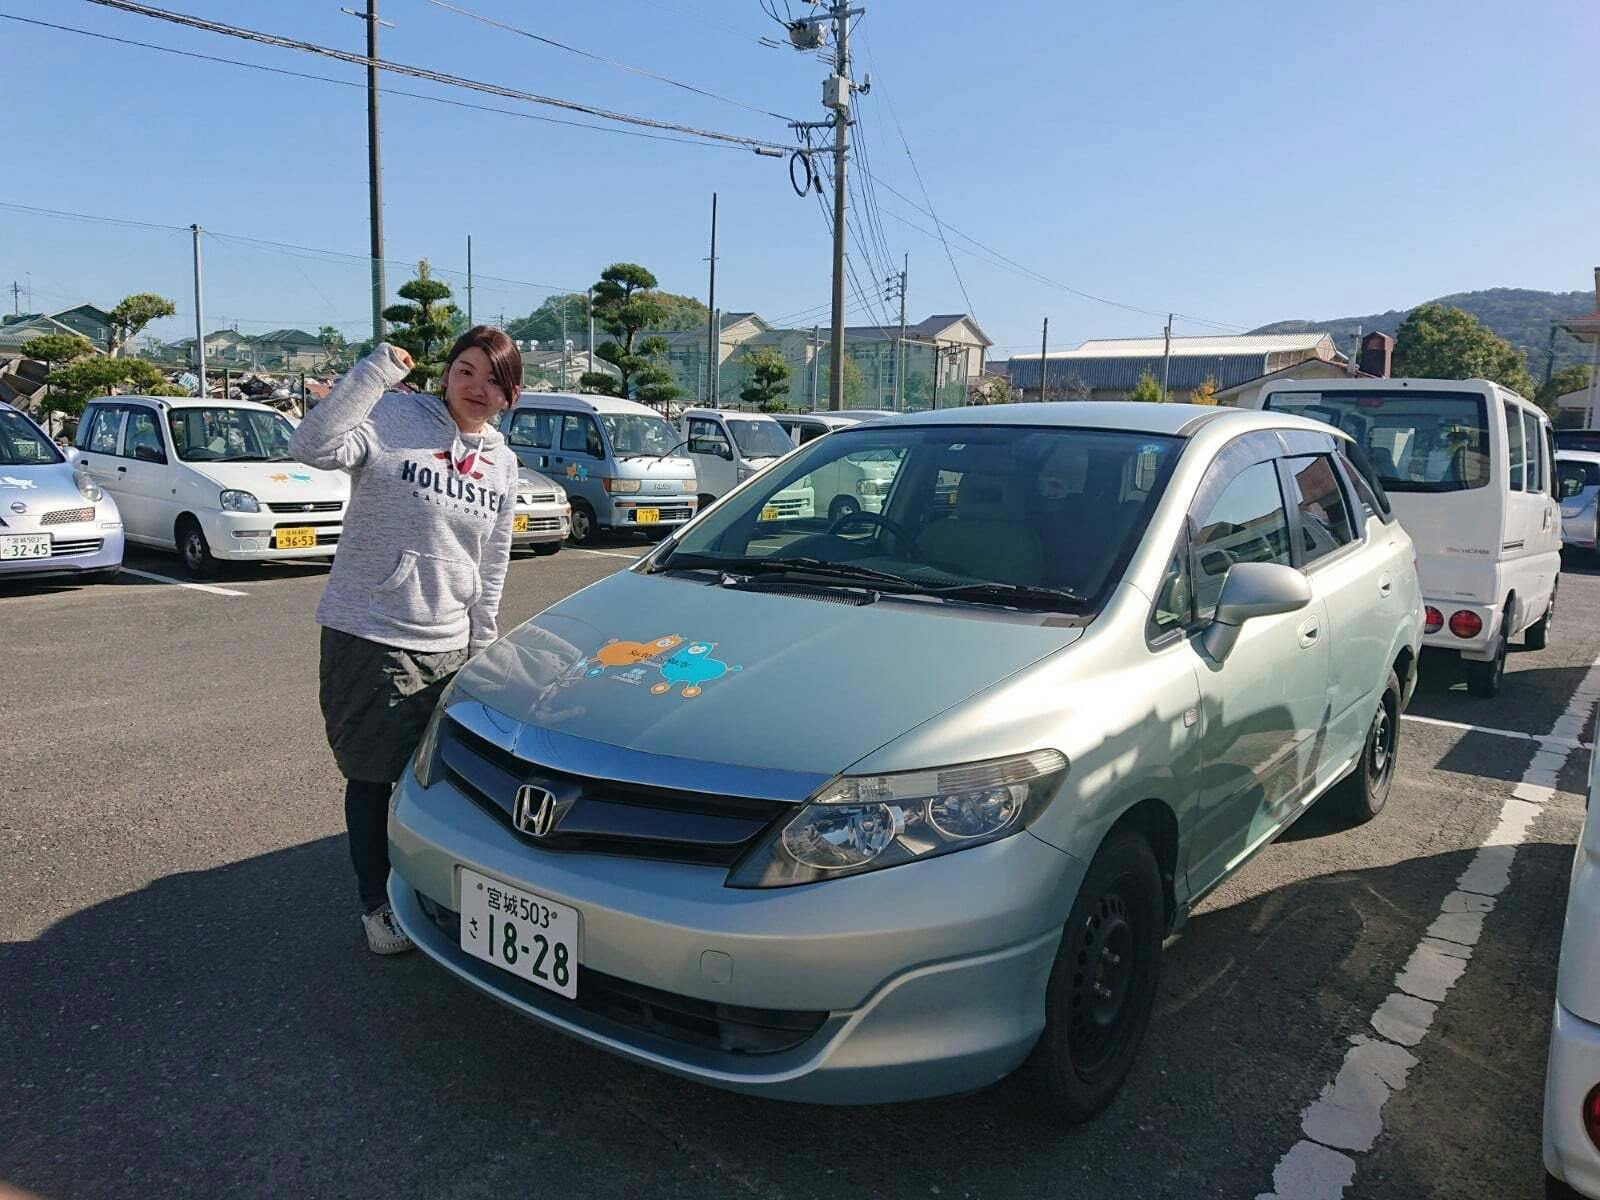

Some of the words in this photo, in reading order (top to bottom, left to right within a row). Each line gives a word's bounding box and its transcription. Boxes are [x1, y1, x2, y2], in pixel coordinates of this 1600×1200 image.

[413, 491, 496, 523] CALIFORN
[11, 543, 48, 556] 32-45
[285, 535, 314, 546] 96-53
[488, 914, 569, 987] 18-28
